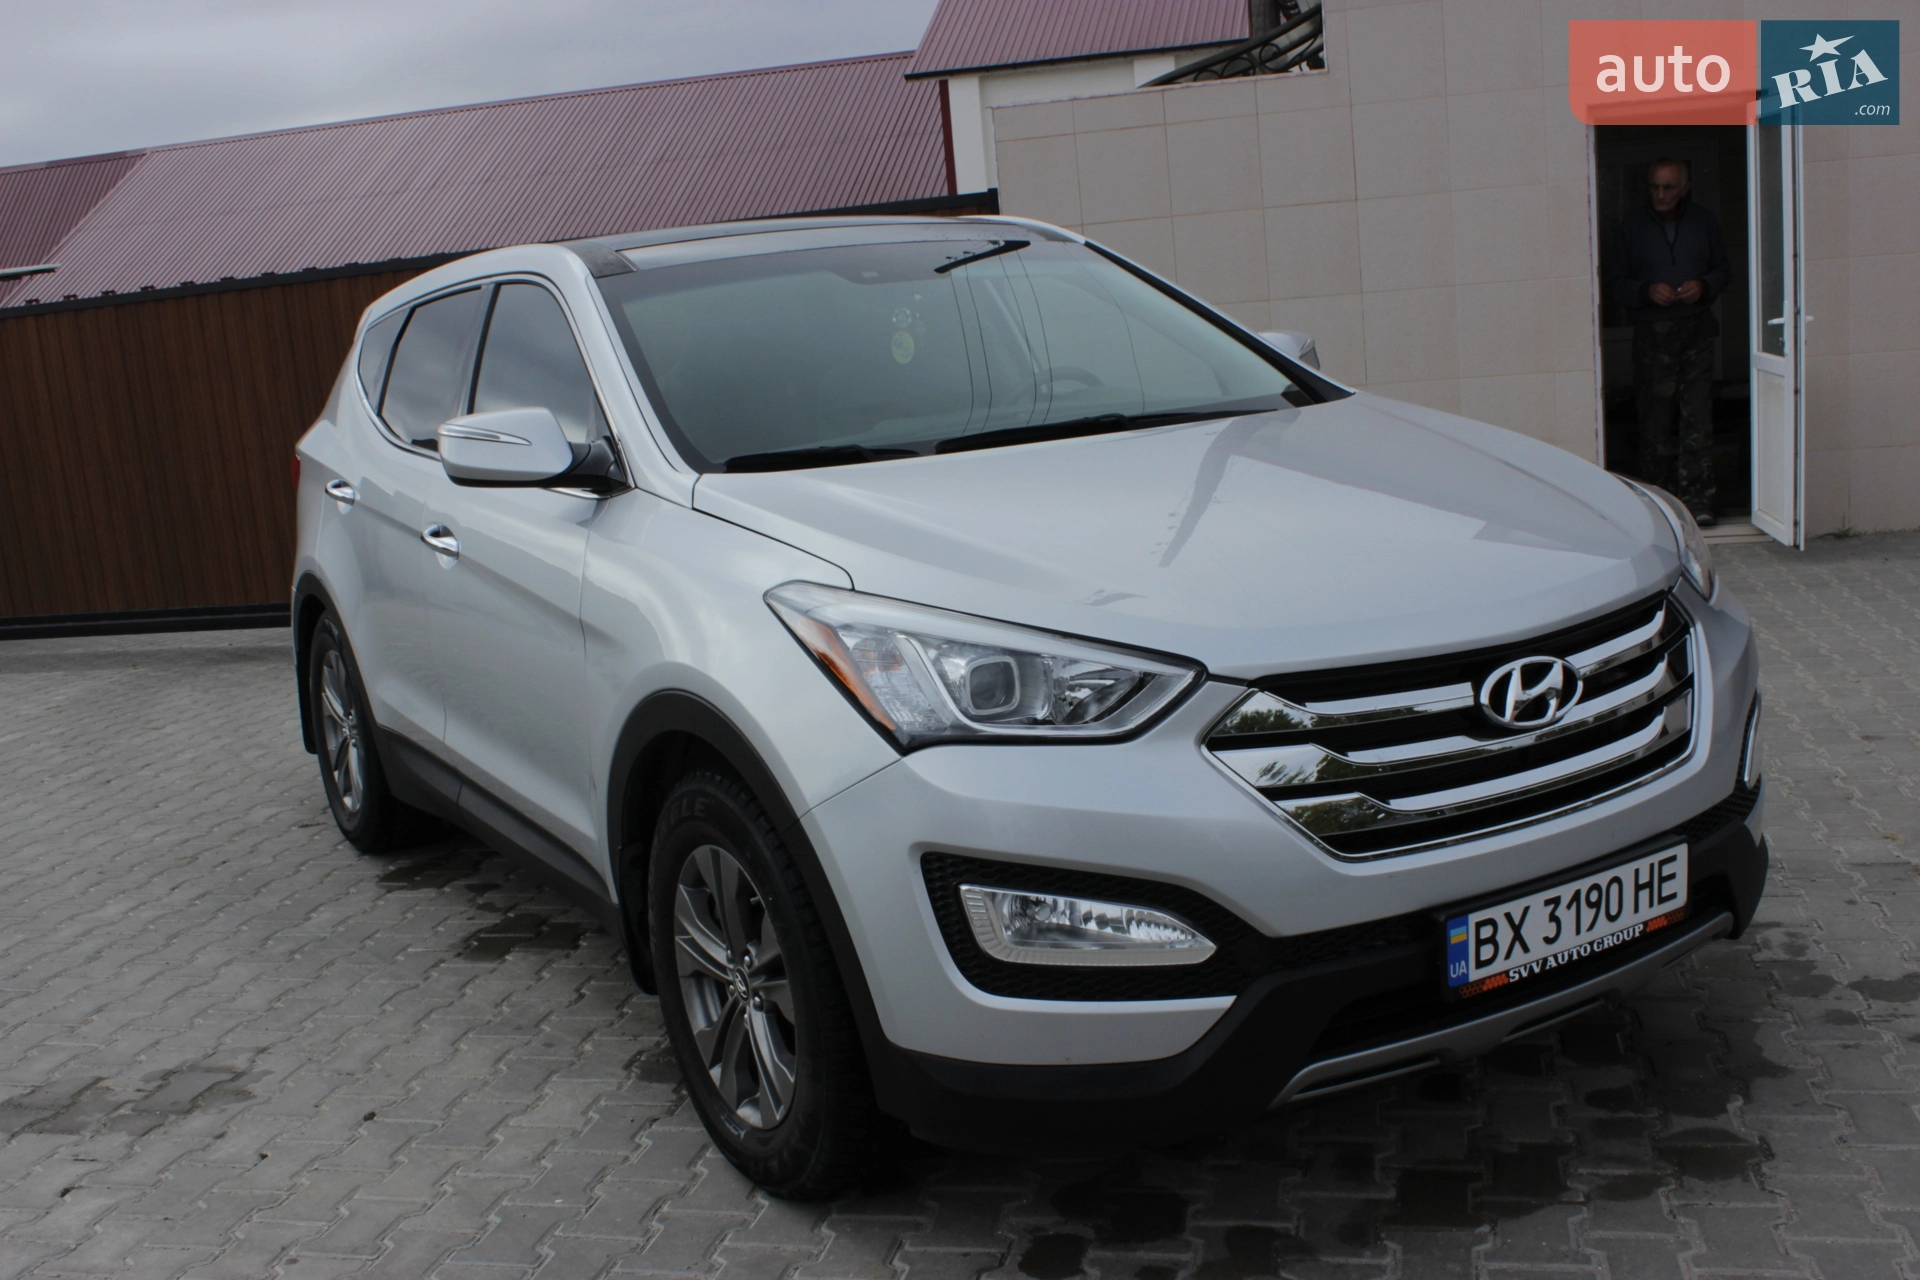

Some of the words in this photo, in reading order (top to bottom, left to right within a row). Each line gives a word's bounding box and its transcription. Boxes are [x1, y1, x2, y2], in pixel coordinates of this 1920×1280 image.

[1474, 905, 1531, 970] BX
[1542, 875, 1624, 945] 3190
[1633, 854, 1678, 914] HE
[1450, 960, 1468, 978] UA
[1508, 959, 1543, 983] SVV
[1545, 943, 1591, 970] AUTO
[1593, 923, 1644, 952] GROUP
